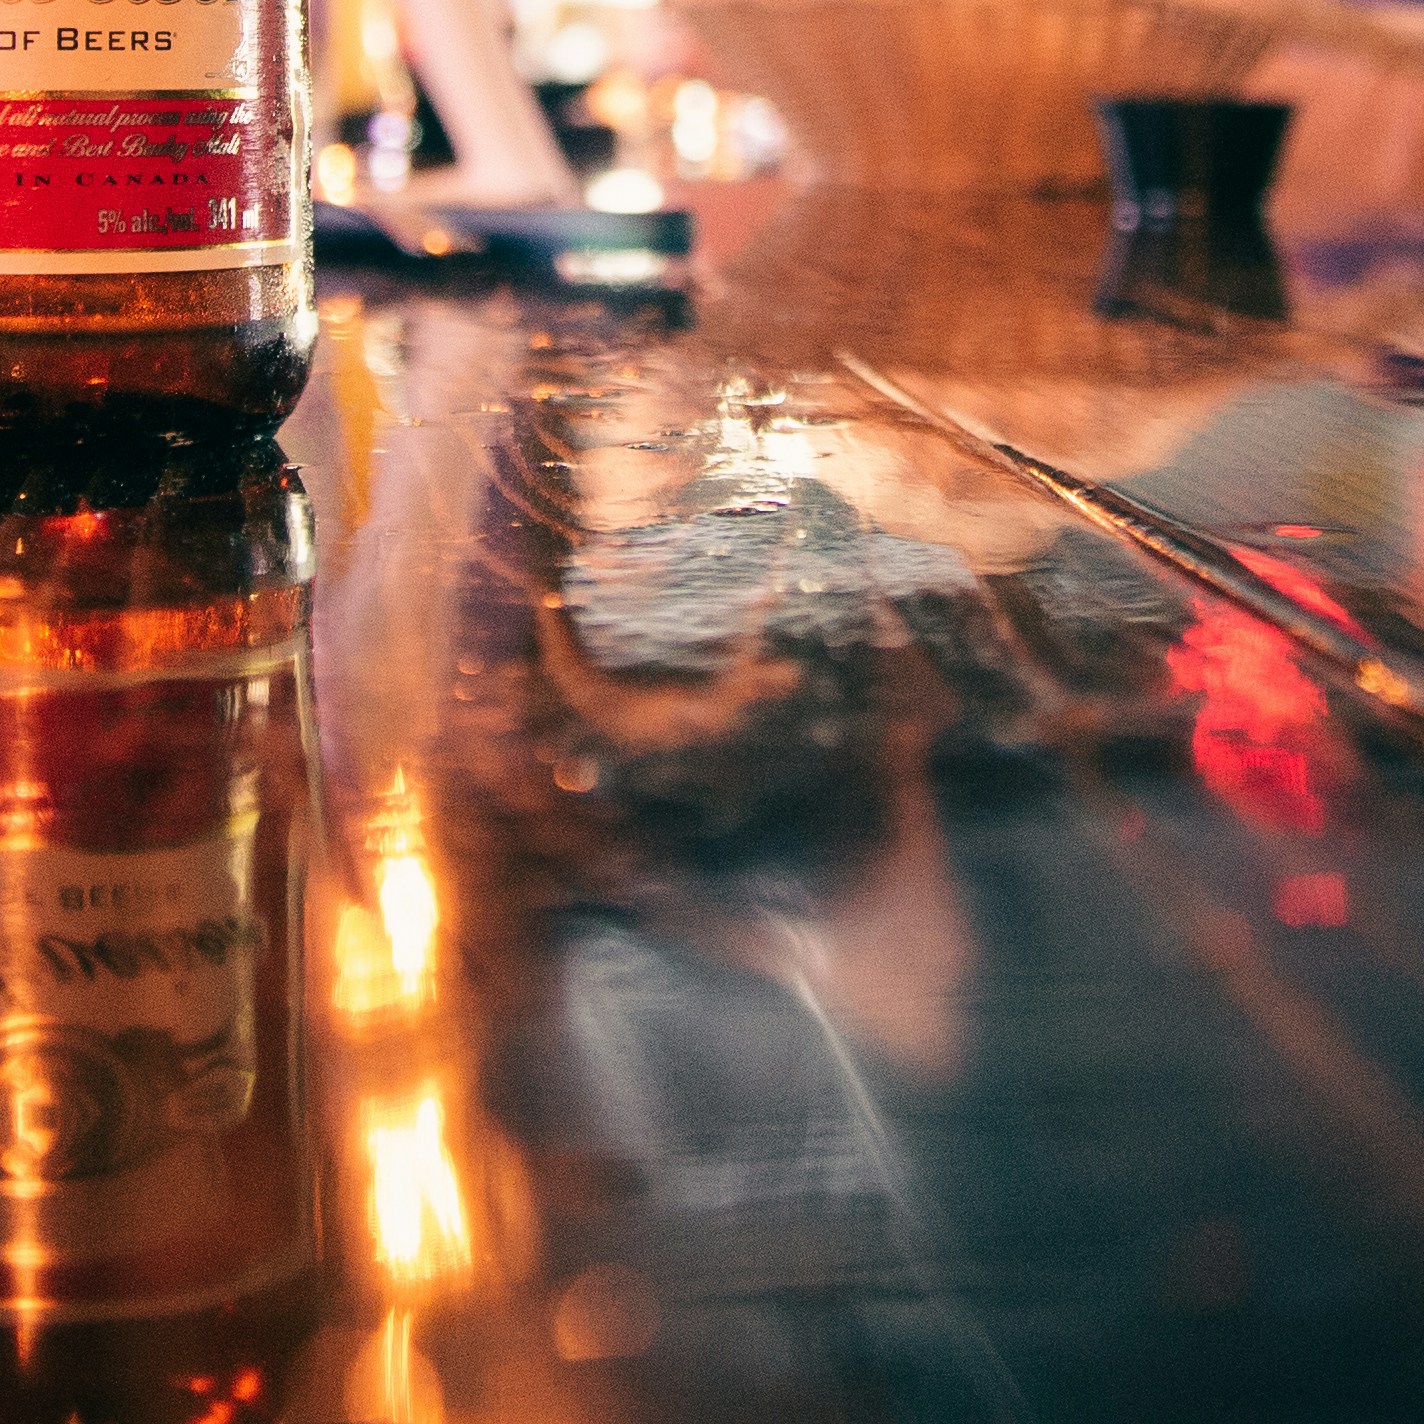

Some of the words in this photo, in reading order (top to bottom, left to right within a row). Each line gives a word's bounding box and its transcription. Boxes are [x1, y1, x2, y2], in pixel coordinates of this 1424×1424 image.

[58, 132, 115, 157] Best
[15, 173, 52, 187] IN
[76, 172, 210, 187] CANADA
[97, 208, 126, 235] 5%
[207, 196, 237, 230] 341
